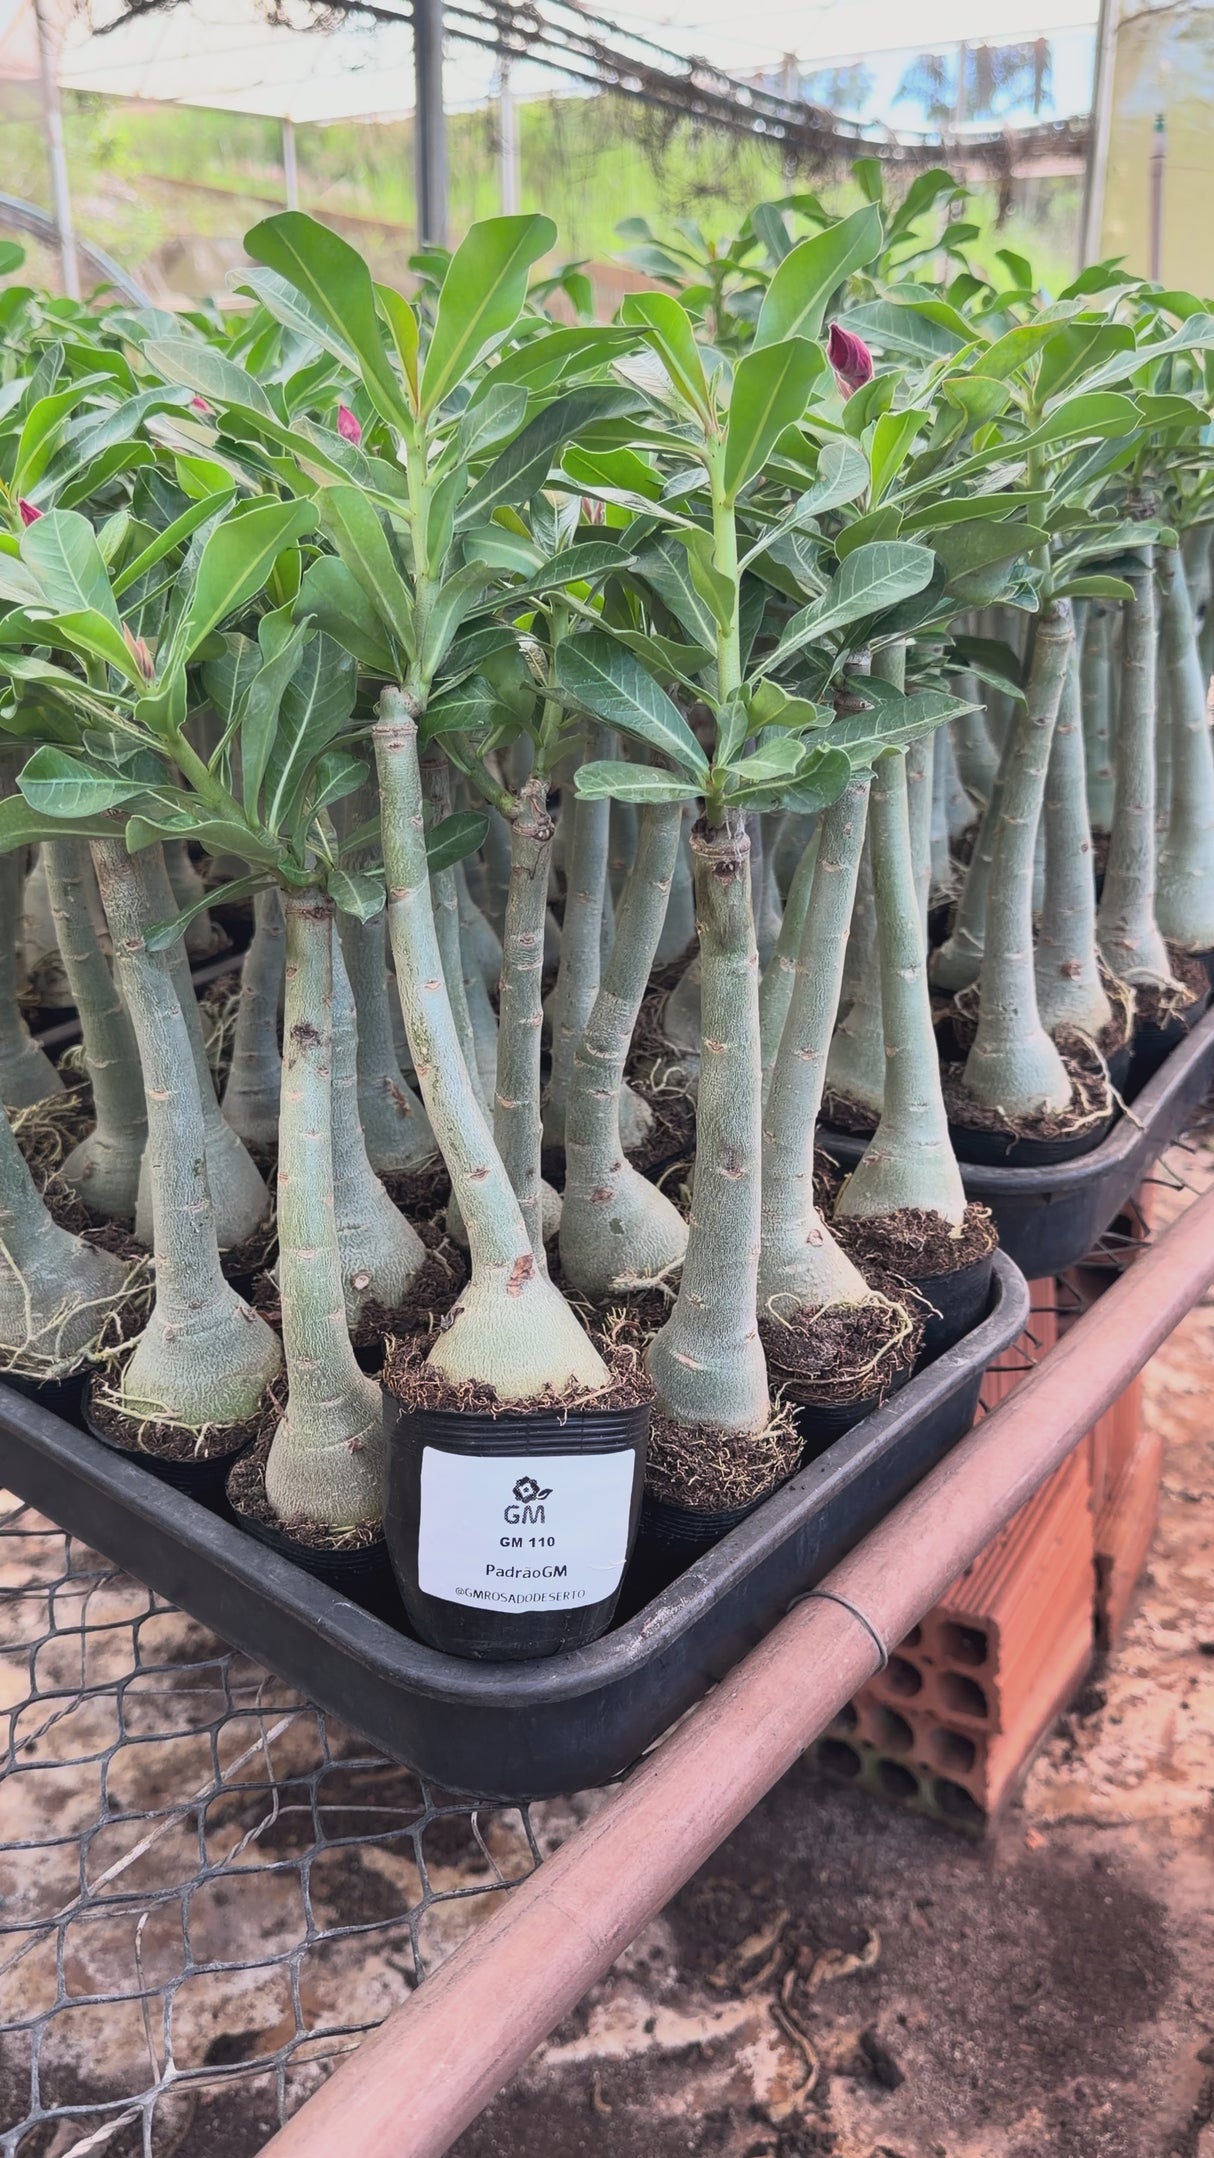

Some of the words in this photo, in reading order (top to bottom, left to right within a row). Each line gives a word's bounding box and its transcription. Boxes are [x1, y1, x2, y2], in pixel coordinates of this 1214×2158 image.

[503, 1504, 546, 1525] GM
[499, 1536, 523, 1548] GM
[528, 1536, 556, 1548] 110
[485, 1564, 568, 1579] PadrãoGM
[455, 1586, 586, 1604] @GMROSADODESERTO
